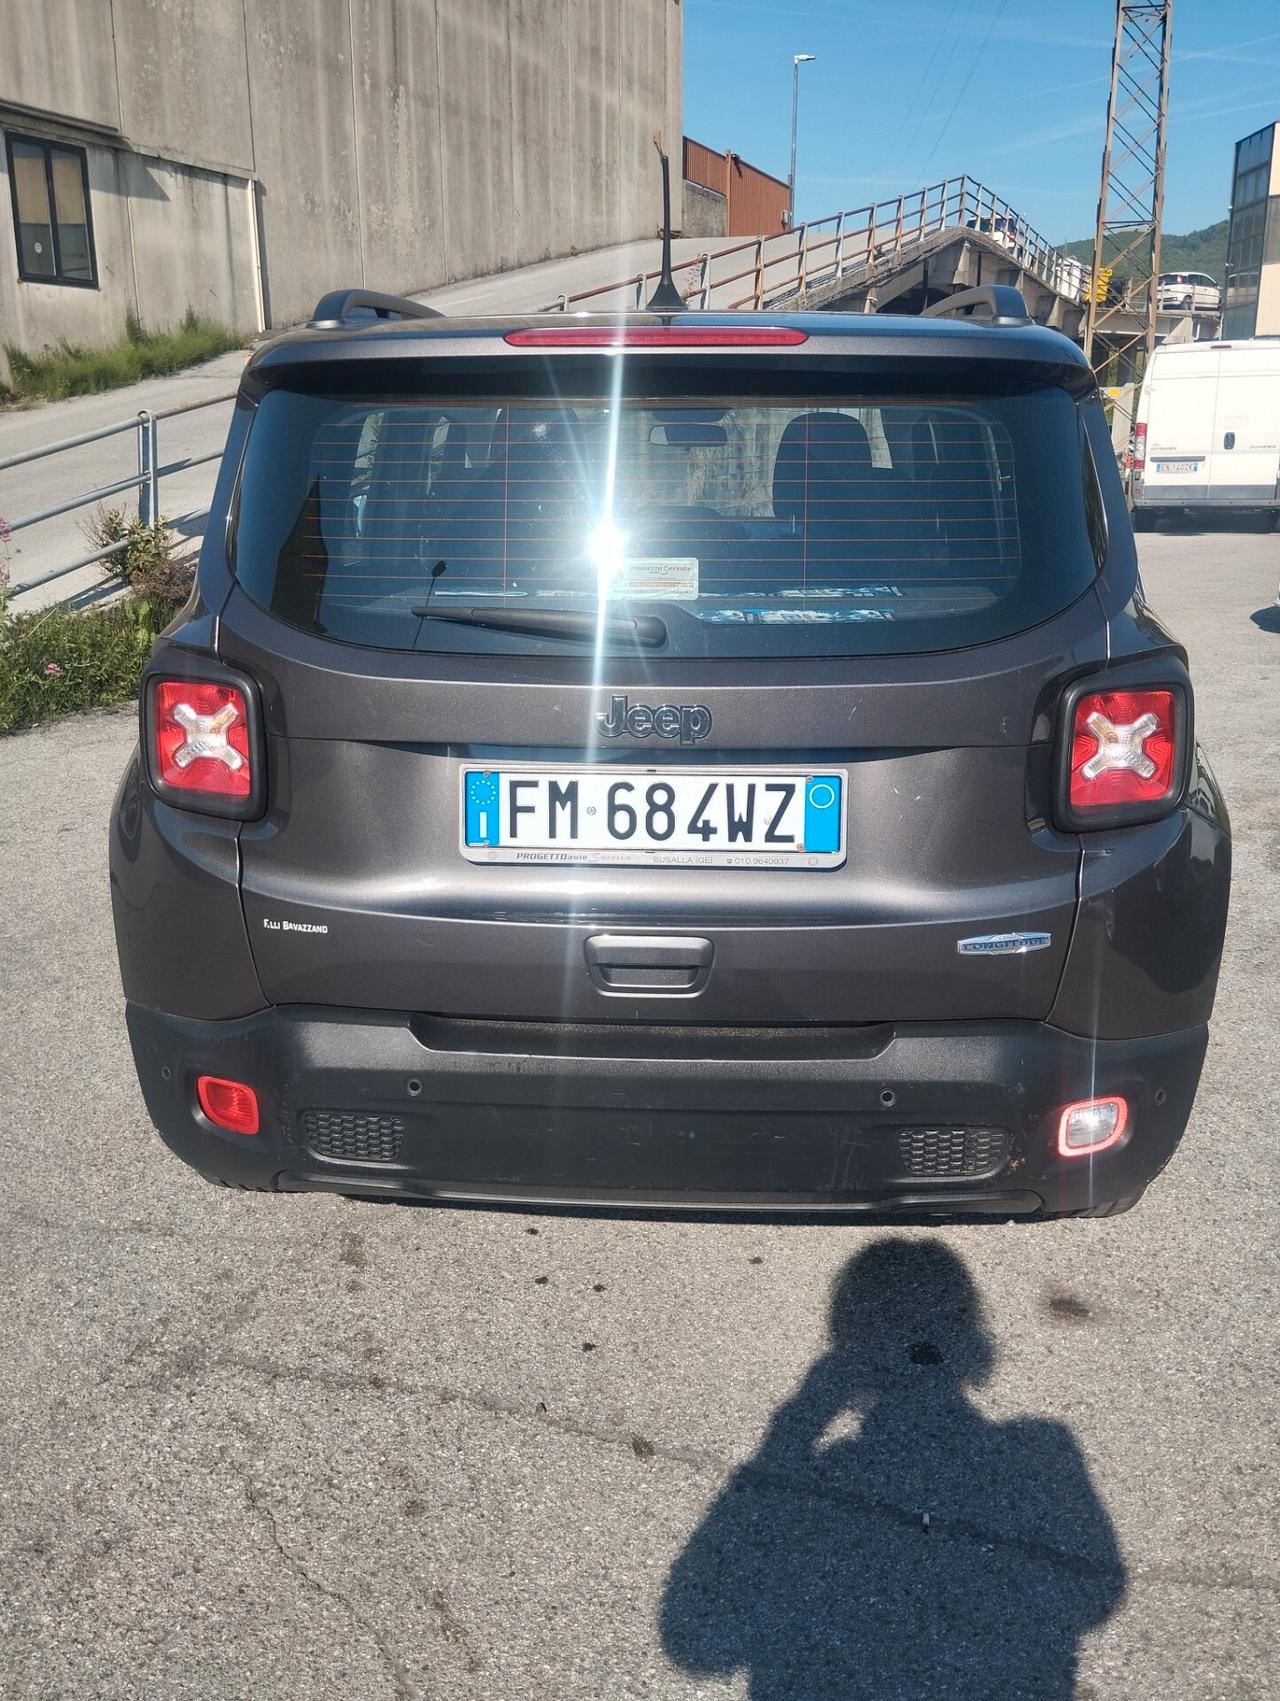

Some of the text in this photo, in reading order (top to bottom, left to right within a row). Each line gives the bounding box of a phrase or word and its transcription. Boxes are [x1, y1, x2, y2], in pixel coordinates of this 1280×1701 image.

[595, 695, 713, 746] Jeep
[509, 780, 579, 839] FM
[607, 781, 796, 843] 684WZ
[653, 856, 693, 864] BUSALLA
